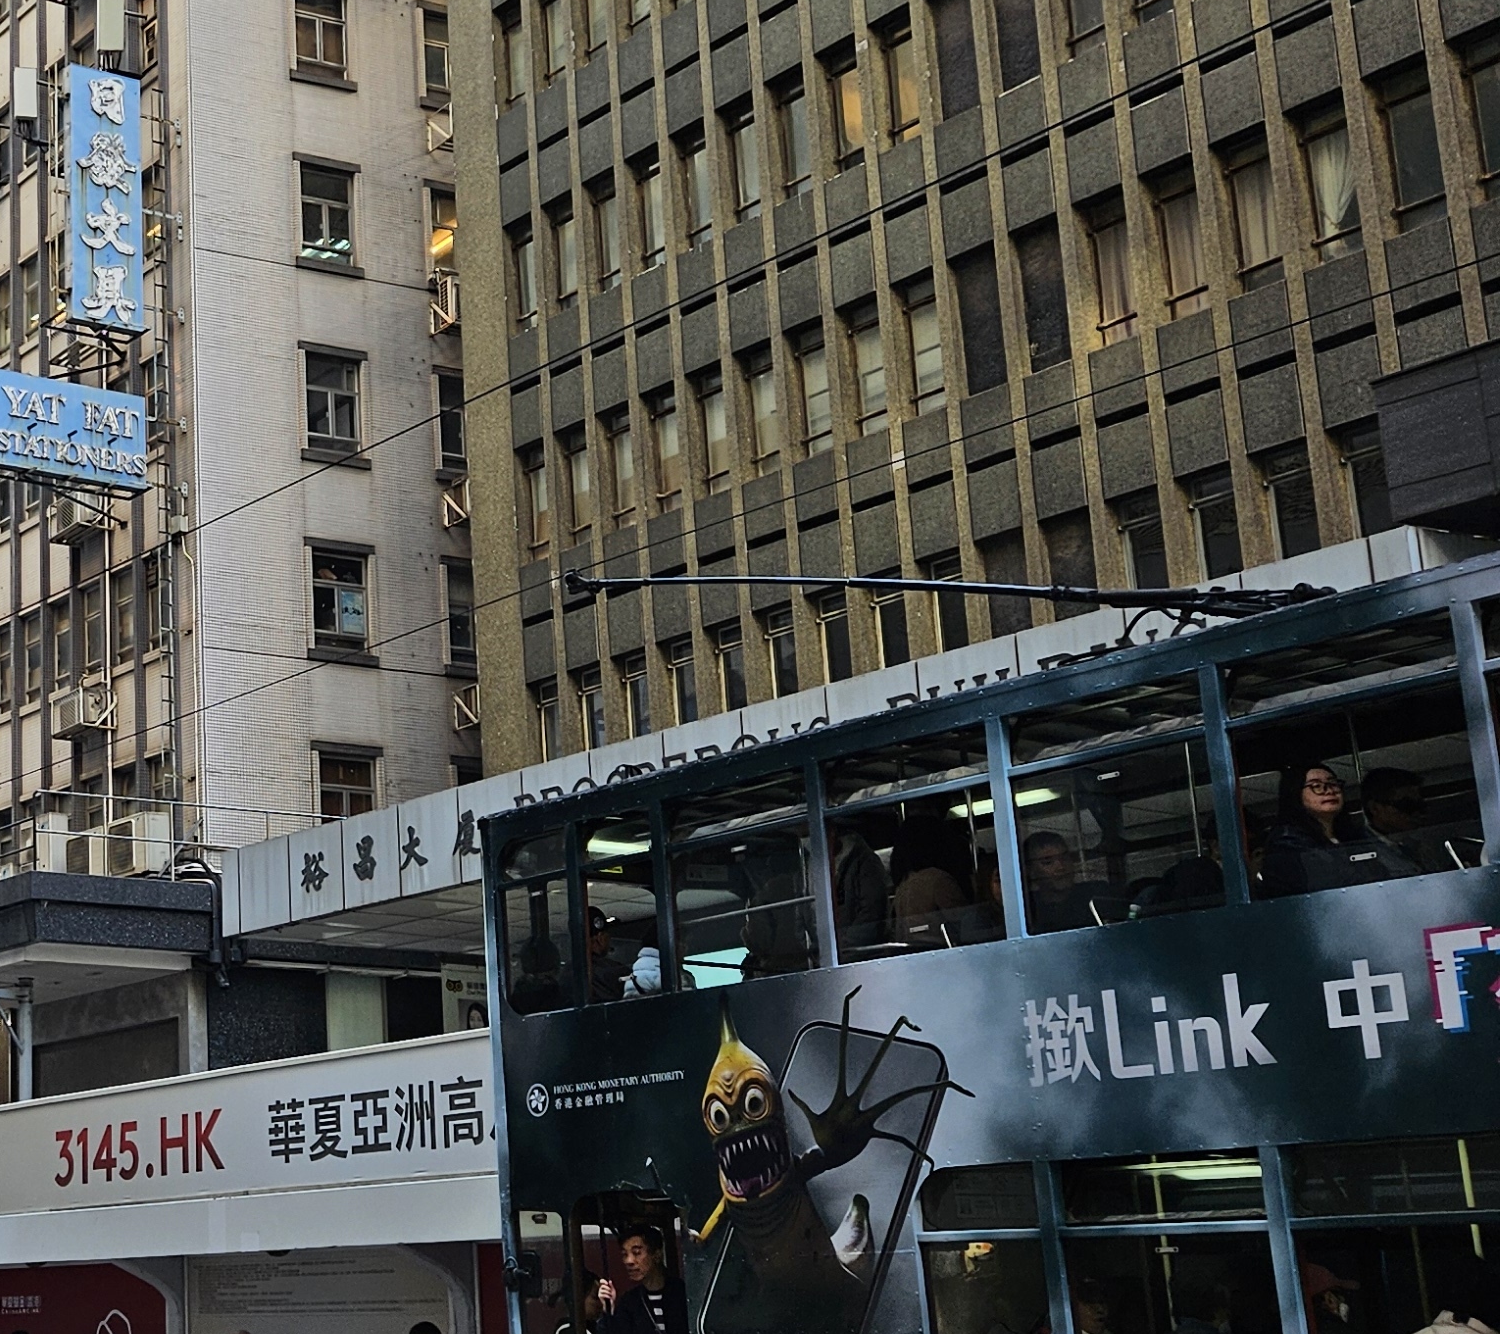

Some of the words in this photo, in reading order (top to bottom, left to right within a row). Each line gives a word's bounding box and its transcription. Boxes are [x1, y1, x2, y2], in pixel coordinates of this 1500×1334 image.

[76, 76, 139, 324] 日發文具
[1, 384, 67, 425] YAT
[82, 400, 141, 440] FAT
[300, 809, 481, 894] 裕昌大廈
[553, 1084, 574, 1095] HONG
[575, 1081, 597, 1092] KONG
[598, 1076, 640, 1090] MONETARY
[640, 1070, 685, 1085] AUTHORITY
[554, 1091, 625, 1110] 香港金融管理局
[54, 1107, 226, 1188] 3145.HK
[268, 1075, 496, 1164] 華夏亞洲高
